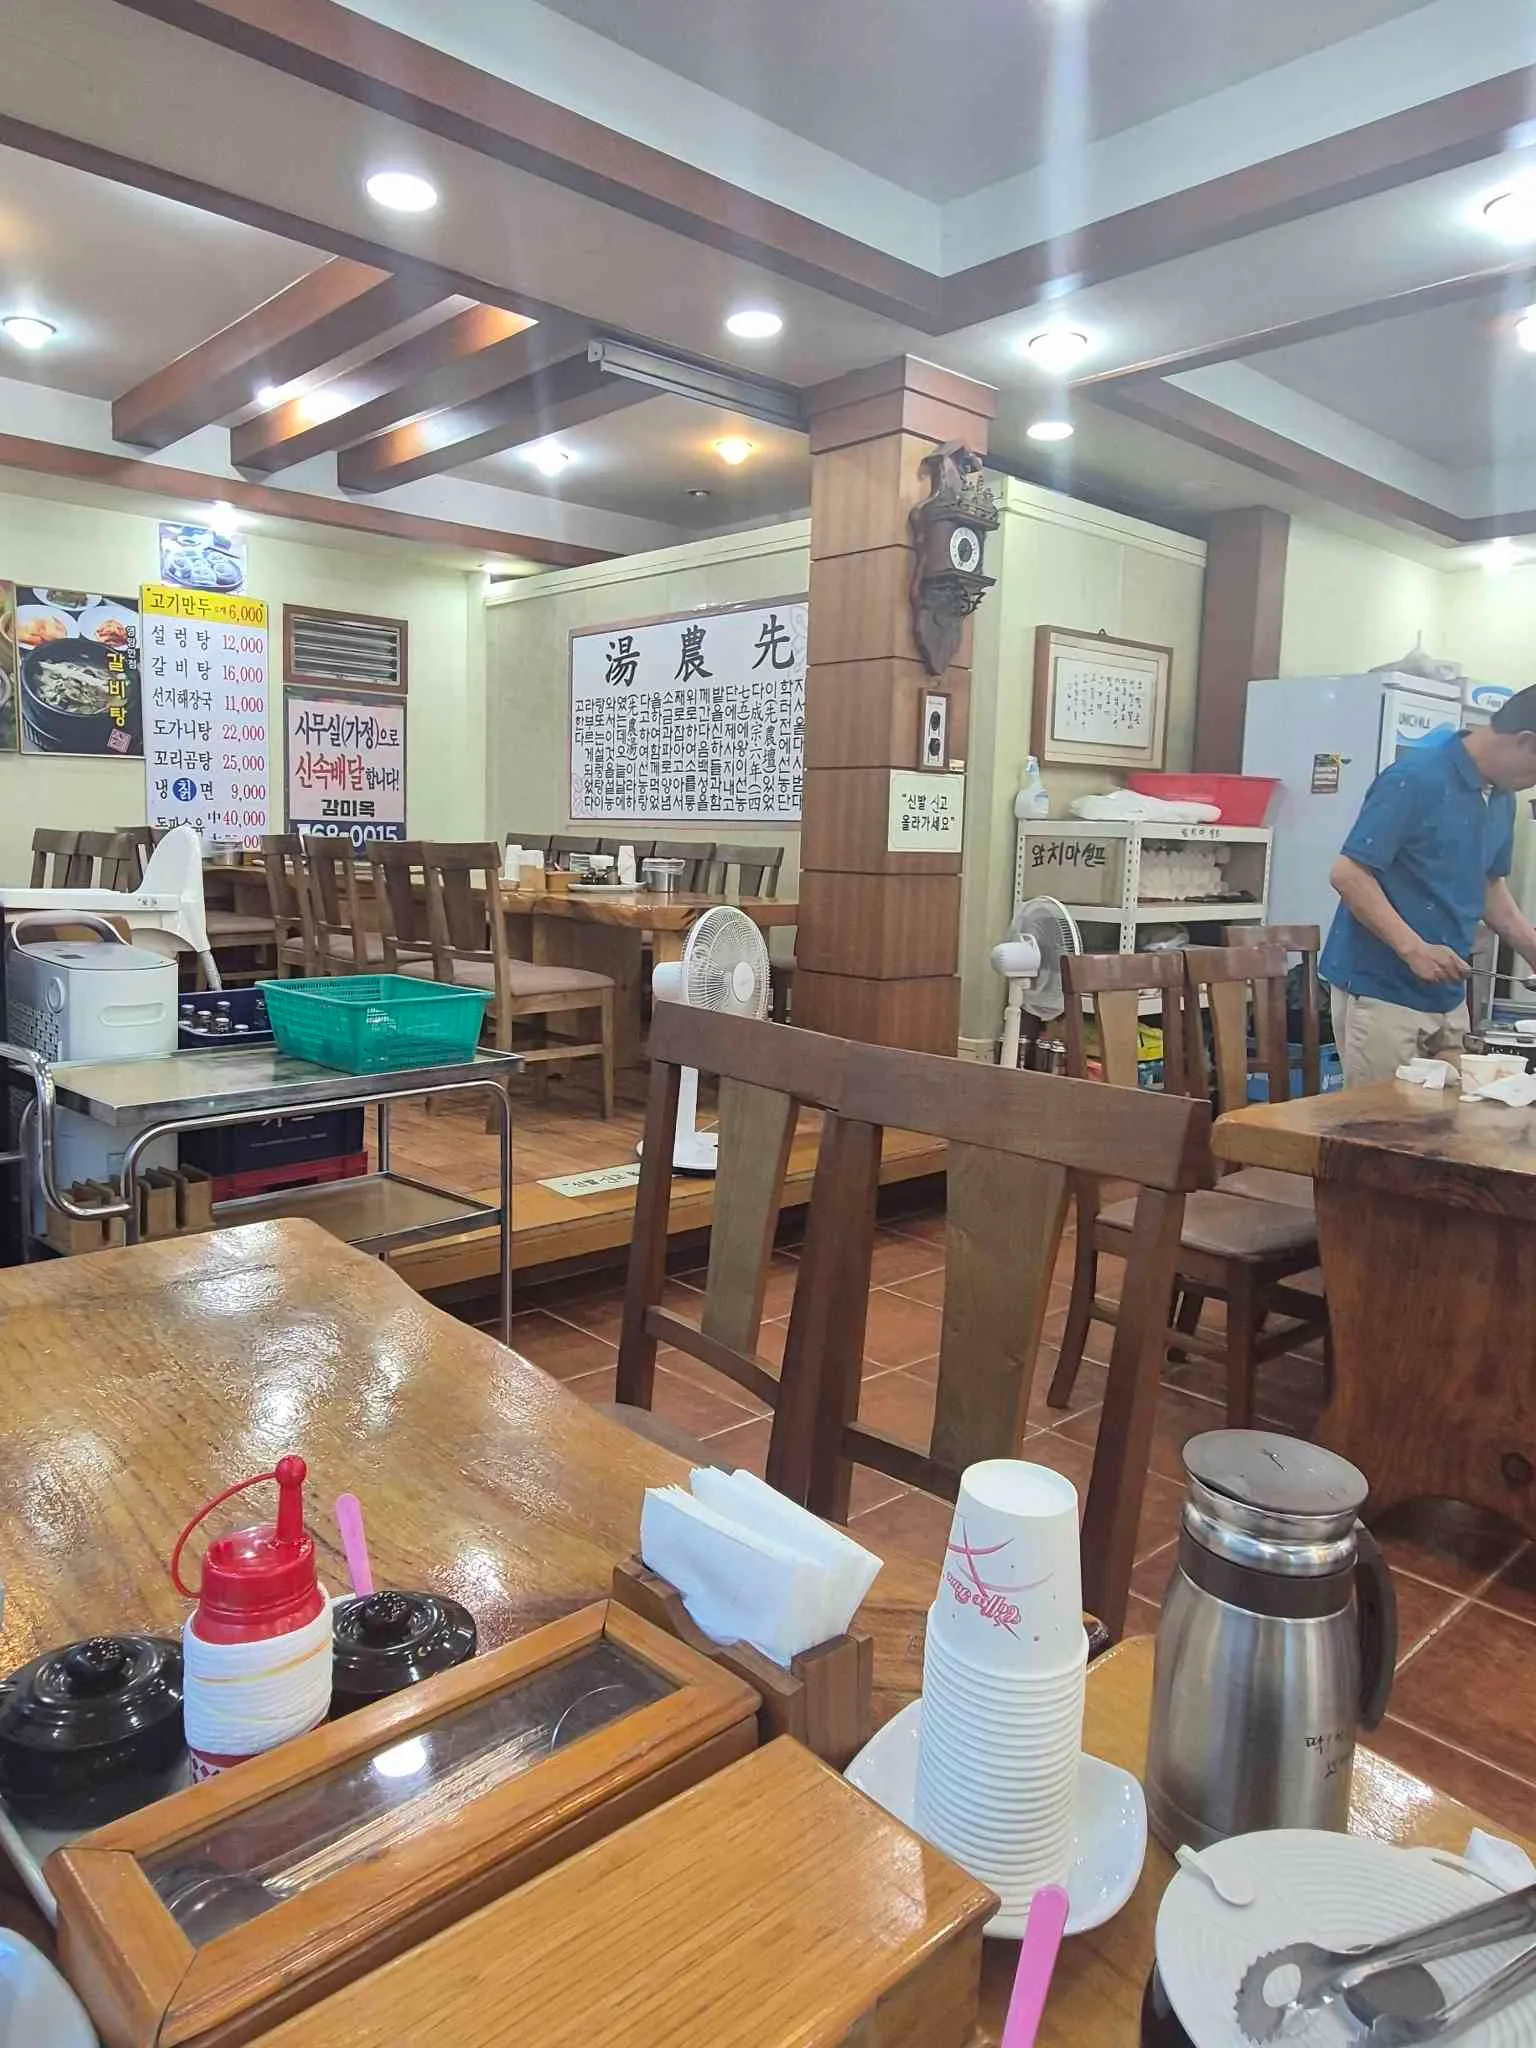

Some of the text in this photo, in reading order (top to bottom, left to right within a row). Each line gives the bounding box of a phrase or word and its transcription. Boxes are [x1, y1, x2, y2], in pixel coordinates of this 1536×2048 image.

[151, 593, 211, 616] 고기만두
[229, 604, 263, 623] 6,000
[223, 634, 263, 654] 12,000
[223, 665, 263, 684] 16,000
[107, 653, 125, 728] 갈비탕
[153, 686, 264, 713] 선지해장국 11,000
[153, 719, 212, 741] 도가니탕
[223, 724, 265, 742] 22,000
[295, 711, 400, 749] 사무실(가정)으로
[154, 749, 265, 773] 꼬리곰탕 25,000
[295, 751, 400, 792] 신속배달 합니다!
[232, 784, 266, 802] 9,000
[223, 810, 266, 828] 40,000
[321, 799, 375, 818] 감미옥
